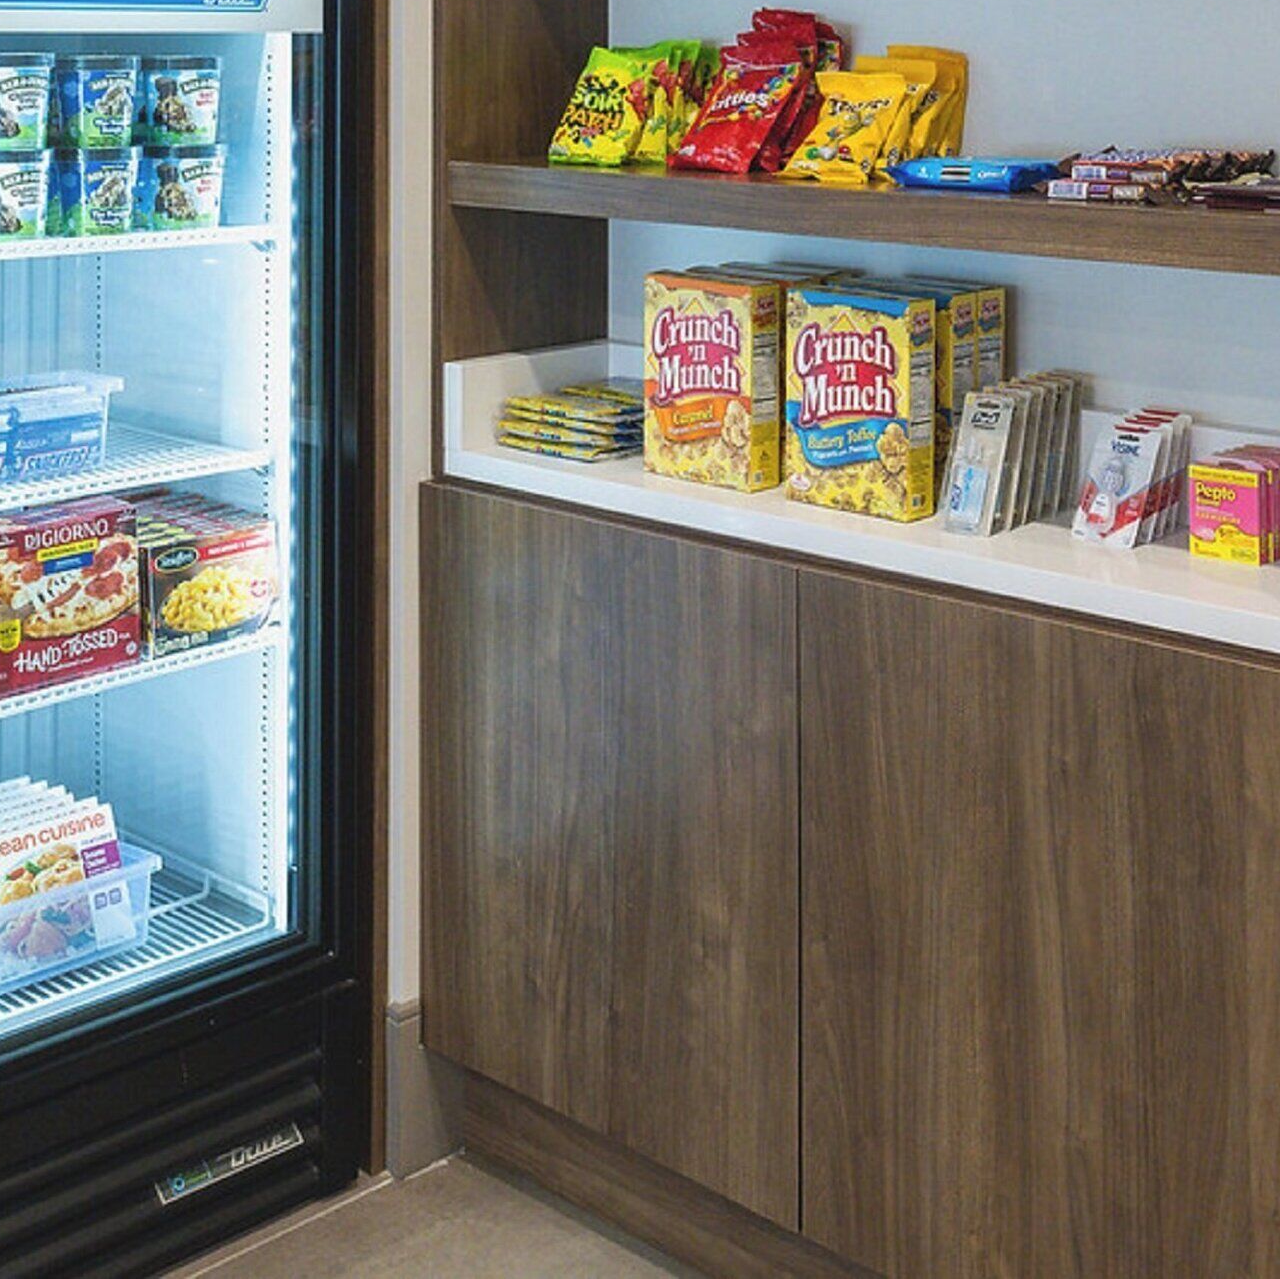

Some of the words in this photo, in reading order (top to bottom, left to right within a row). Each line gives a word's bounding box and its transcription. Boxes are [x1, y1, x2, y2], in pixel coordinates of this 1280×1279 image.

[653, 309, 739, 353] Crunch
[796, 322, 894, 372] Crunch
[658, 355, 739, 400] Munch
[801, 376, 895, 420] Munch
[807, 433, 845, 450] Buttery
[1196, 481, 1237, 502] Pepto
[24, 518, 109, 550] DIGIORNO
[13, 627, 118, 672] HAND-TOSSED
